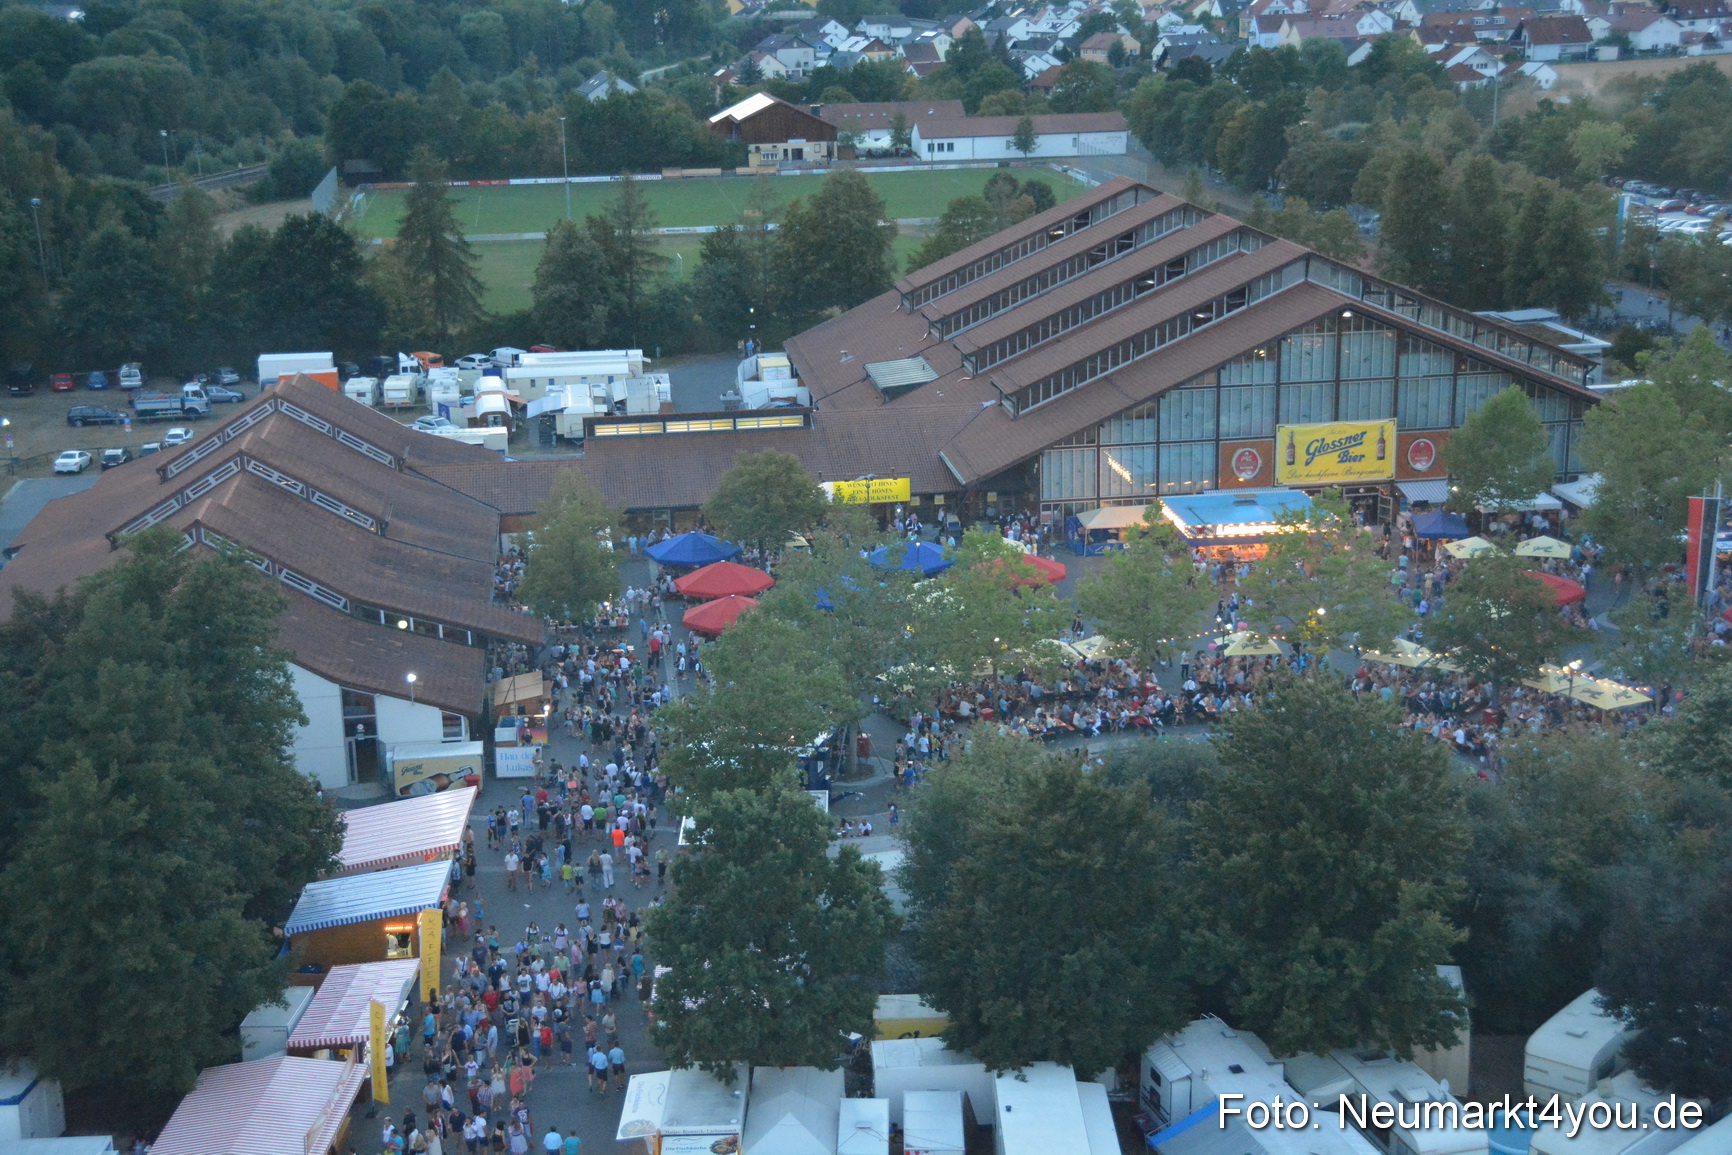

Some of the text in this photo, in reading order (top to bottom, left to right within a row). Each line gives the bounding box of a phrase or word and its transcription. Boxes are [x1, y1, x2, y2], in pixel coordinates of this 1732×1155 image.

[1304, 431, 1367, 467] Glossner
[1337, 450, 1366, 465] Bier
[500, 752, 518, 761] Hau
[506, 763, 533, 772] Lukas
